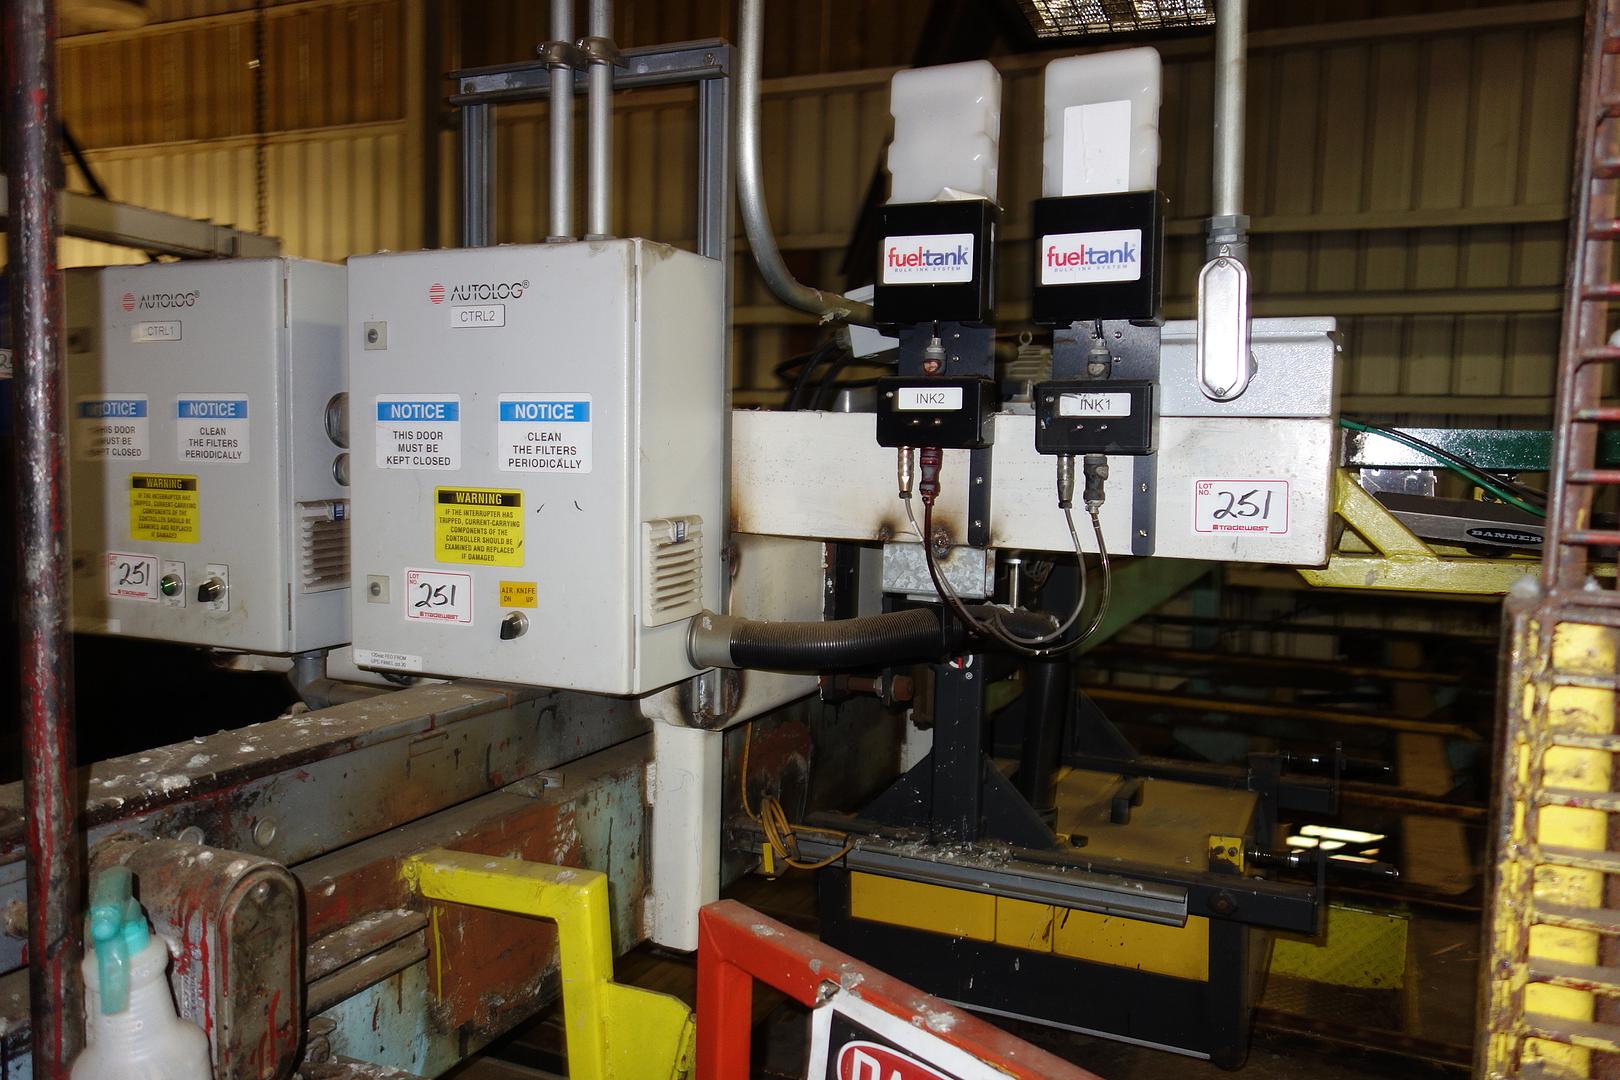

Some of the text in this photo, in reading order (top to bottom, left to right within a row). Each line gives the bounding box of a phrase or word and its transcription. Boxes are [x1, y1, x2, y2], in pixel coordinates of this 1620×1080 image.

[460, 310, 495, 322] CTRL2
[147, 326, 175, 337] CTRL1
[916, 393, 945, 405] INK2
[1080, 398, 1111, 411] INK1
[190, 402, 235, 416] NOTICE
[391, 404, 445, 419] NOTICE
[515, 403, 574, 419] NOTICE
[114, 425, 136, 434] DOOR
[200, 426, 227, 436] CLEAN
[393, 430, 444, 441] THIS DOOR
[527, 431, 562, 442] CLEAN
[122, 437, 133, 446] BE
[188, 438, 239, 448] THE FILTERS
[112, 447, 142, 457] CLOSED
[398, 443, 439, 453] MUST BE
[513, 444, 577, 456] THE FILTERS
[185, 449, 242, 460] PERIODICALLY
[386, 455, 451, 466] KEPT CLOSED
[508, 457, 582, 469] PERIODICALLY
[146, 477, 183, 489] WARNING
[456, 491, 502, 505] WARNING
[1213, 489, 1272, 519] 251
[463, 510, 501, 518] INTERRUPTER
[465, 518, 520, 528] CURRENT-CARRYING
[450, 526, 487, 535] COMPONENTS
[1471, 529, 1543, 543] BANNER
[445, 535, 481, 543] CONTROLLER
[482, 537, 505, 545] SHOULD
[444, 543, 471, 551] EXAMINED
[486, 546, 514, 554] REPLACED
[119, 561, 150, 586] 251
[414, 582, 456, 608] 251
[501, 586, 536, 595] AIR KNIFE
